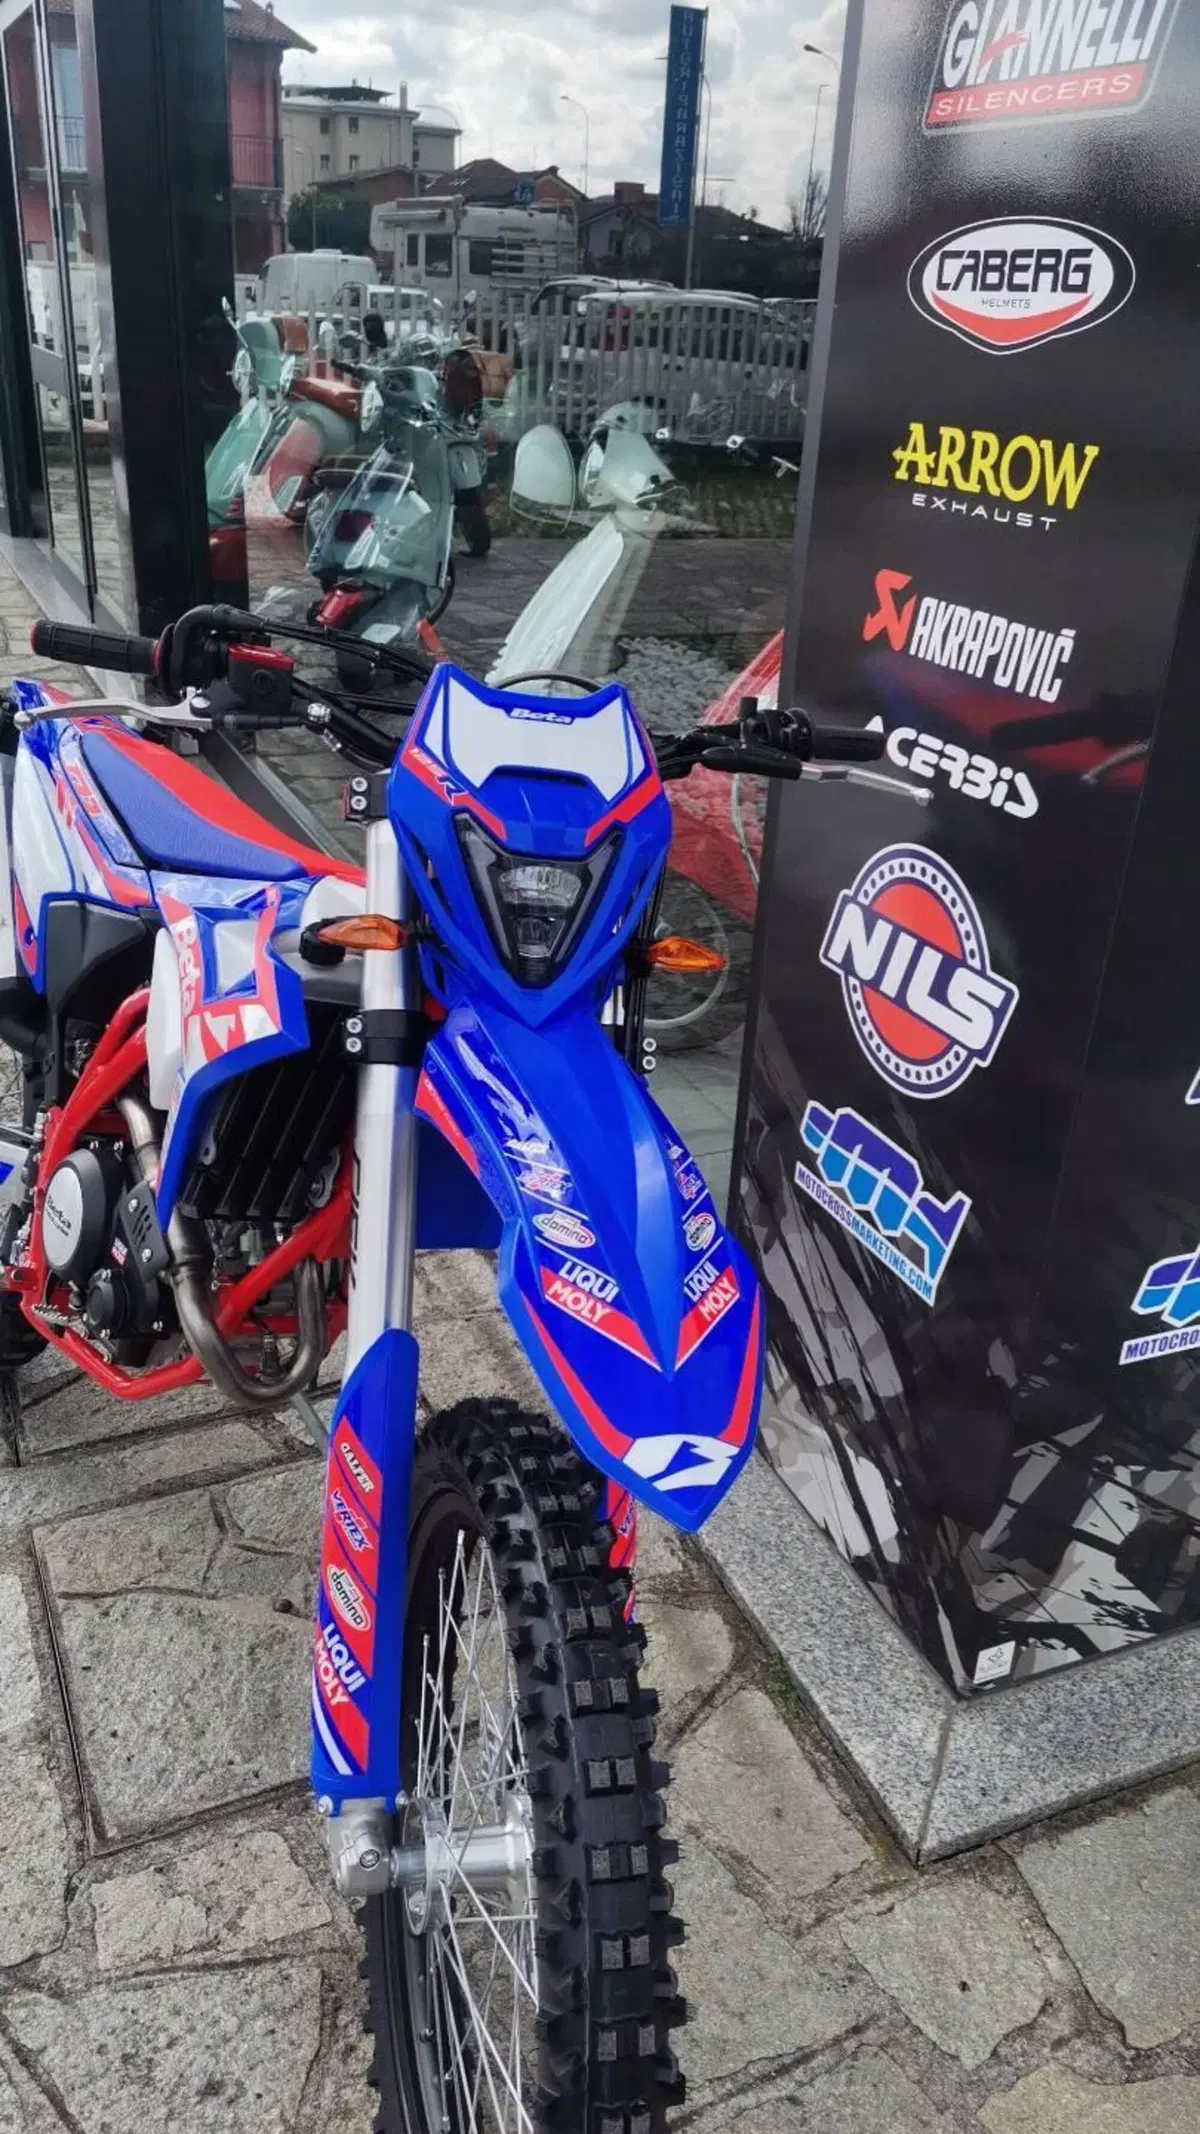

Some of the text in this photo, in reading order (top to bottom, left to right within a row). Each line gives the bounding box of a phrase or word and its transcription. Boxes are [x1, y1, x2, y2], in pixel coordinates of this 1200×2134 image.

[942, 0, 1163, 88] GIANNELLI
[935, 73, 1133, 117] SILENCERS
[936, 248, 1094, 294] CABERG
[981, 298, 1032, 310] HELMETS
[892, 422, 1099, 510] ARROW
[912, 493, 1057, 531] EXHAUST
[169, 915, 201, 1018] Beta
[827, 902, 1006, 1051] NILS
[540, 1213, 589, 1244] domino
[797, 1166, 934, 1298] MOTOCROSSMARKETING.COM
[547, 1279, 613, 1323] MOLY
[557, 1260, 620, 1303] LIQUI
[683, 1260, 720, 1303] LIQUI
[699, 1276, 738, 1321] MOLY
[331, 1490, 372, 1551] VERTEX
[331, 1571, 364, 1629] domino
[315, 1640, 350, 1706] MOLY
[322, 1622, 367, 1693] LIQUI
